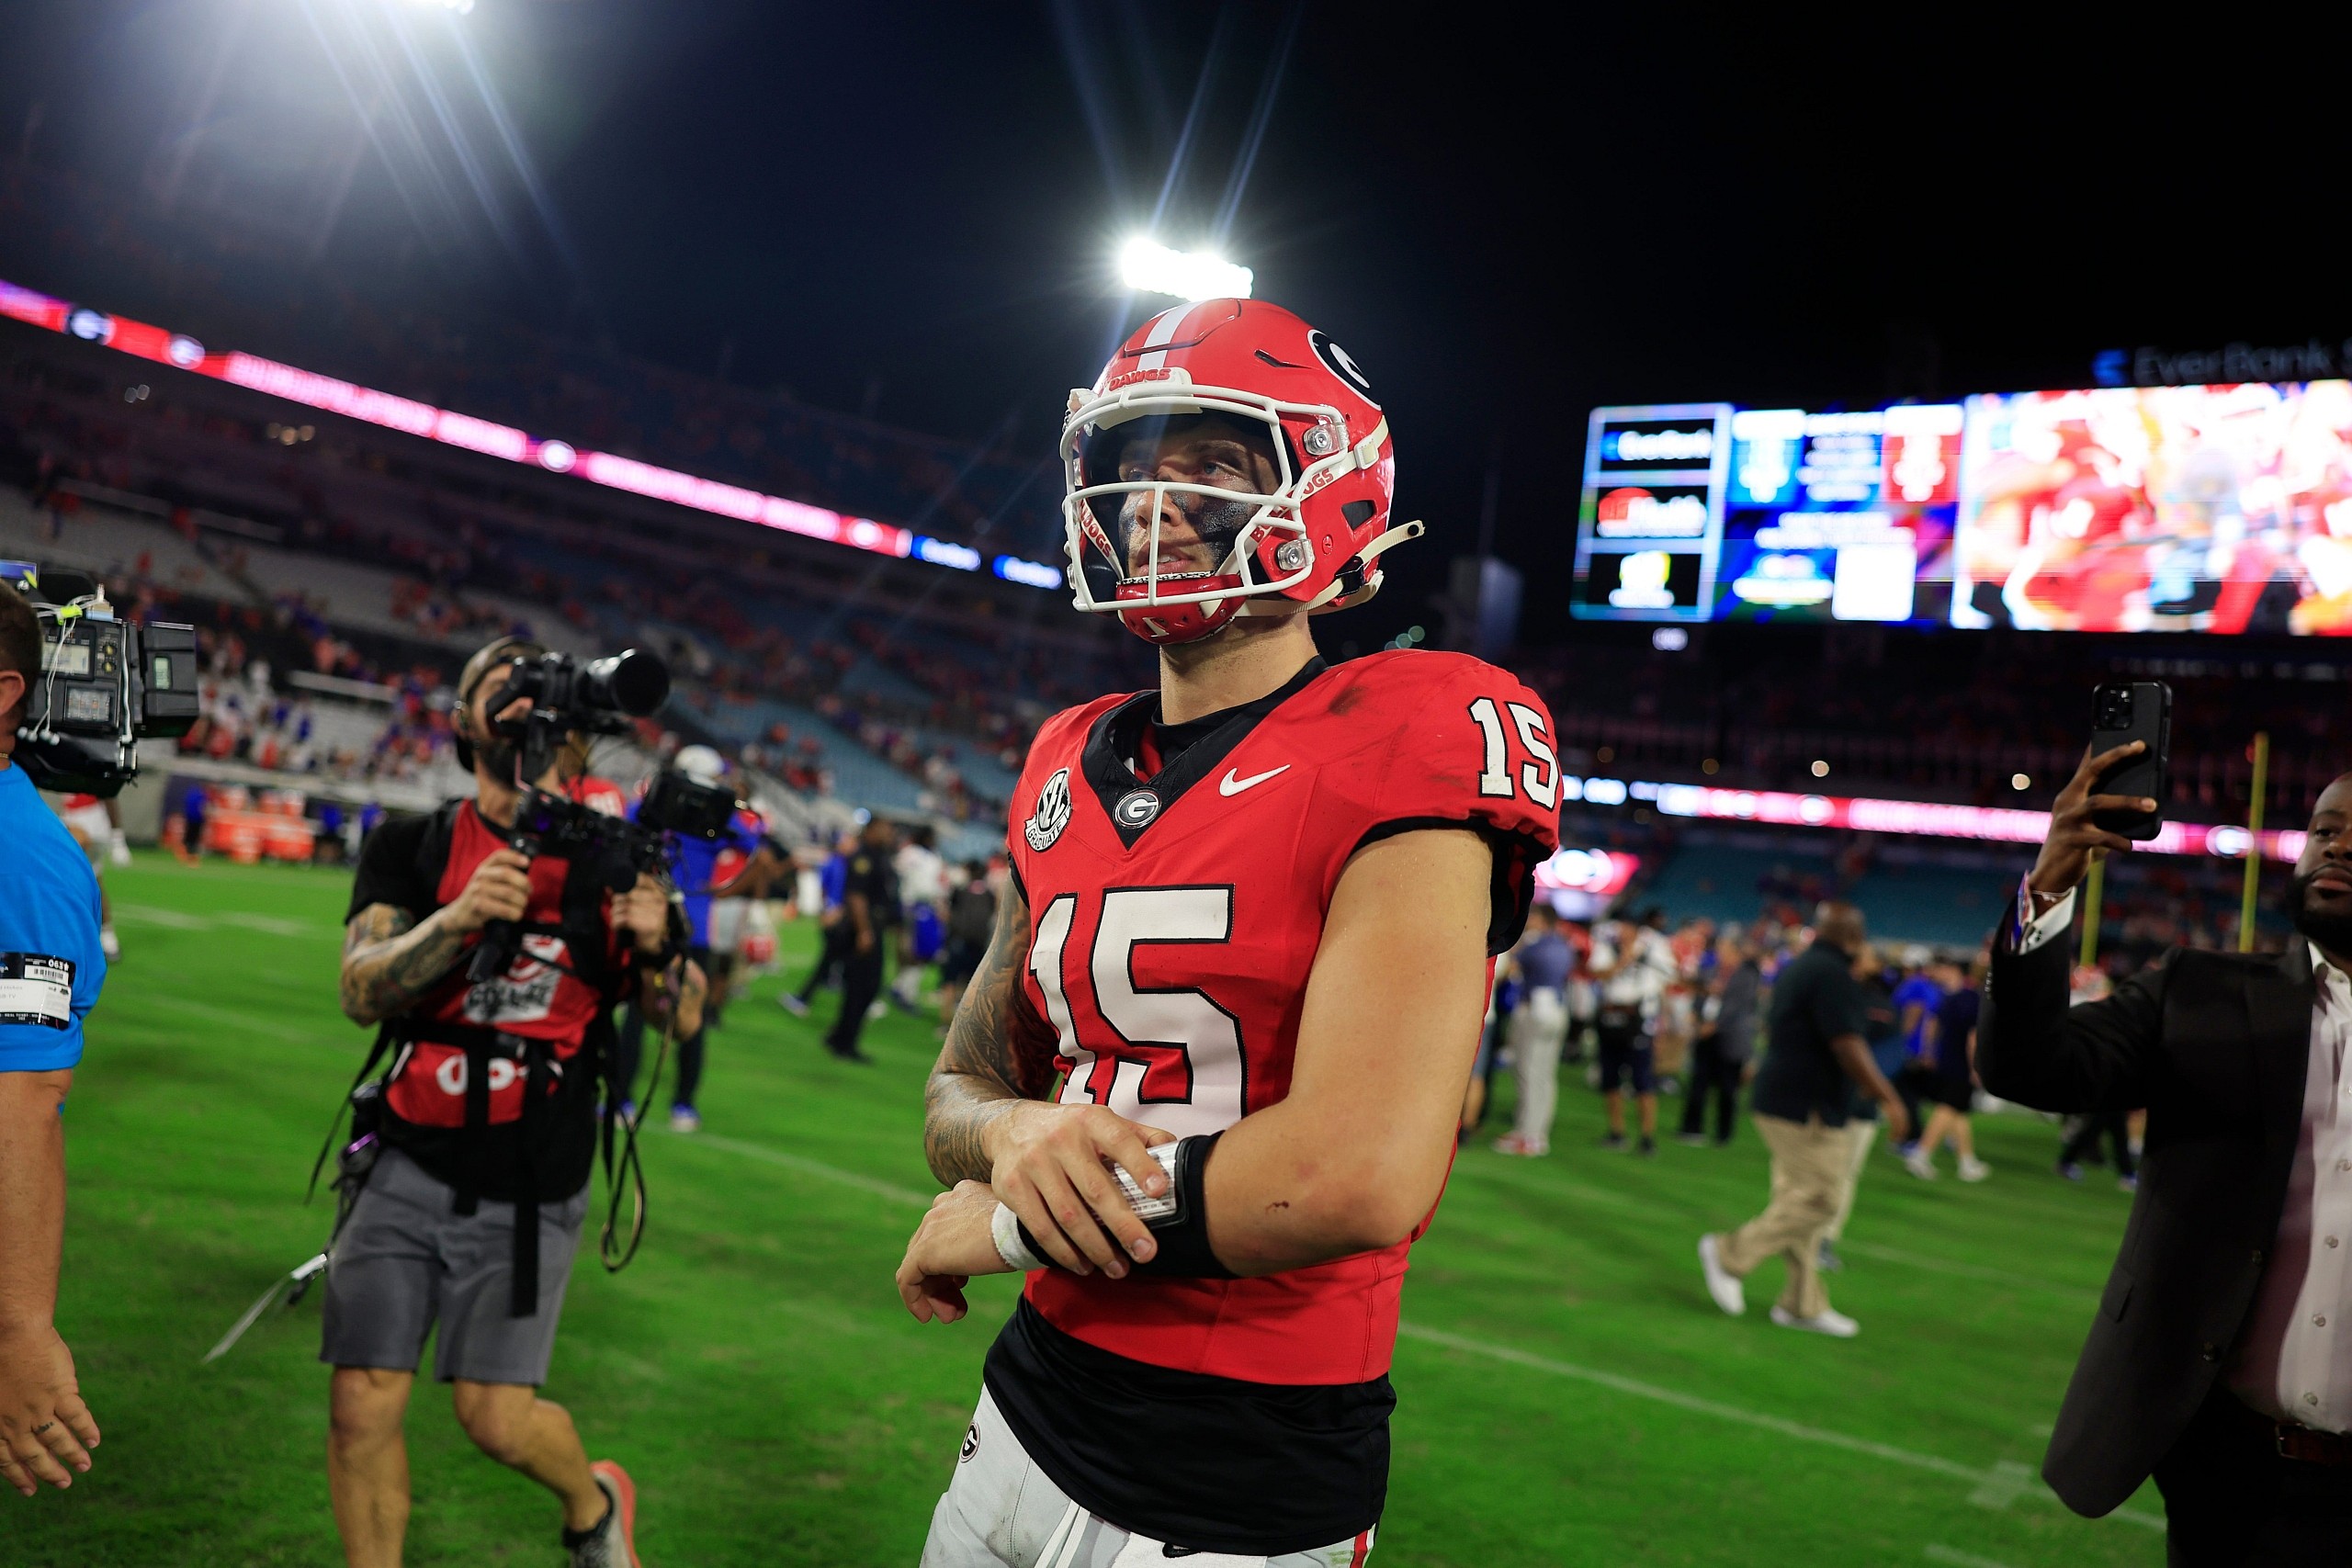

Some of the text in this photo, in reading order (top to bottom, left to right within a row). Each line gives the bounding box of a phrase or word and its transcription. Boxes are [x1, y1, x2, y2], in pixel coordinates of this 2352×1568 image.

[1108, 368, 1171, 391] DAWGS
[1468, 696, 1562, 811] 15
[1037, 773, 1069, 829] SEC
[1127, 798, 1159, 818] G
[1027, 821, 1063, 850] GRADUATE
[1028, 884, 1248, 1138] 15
